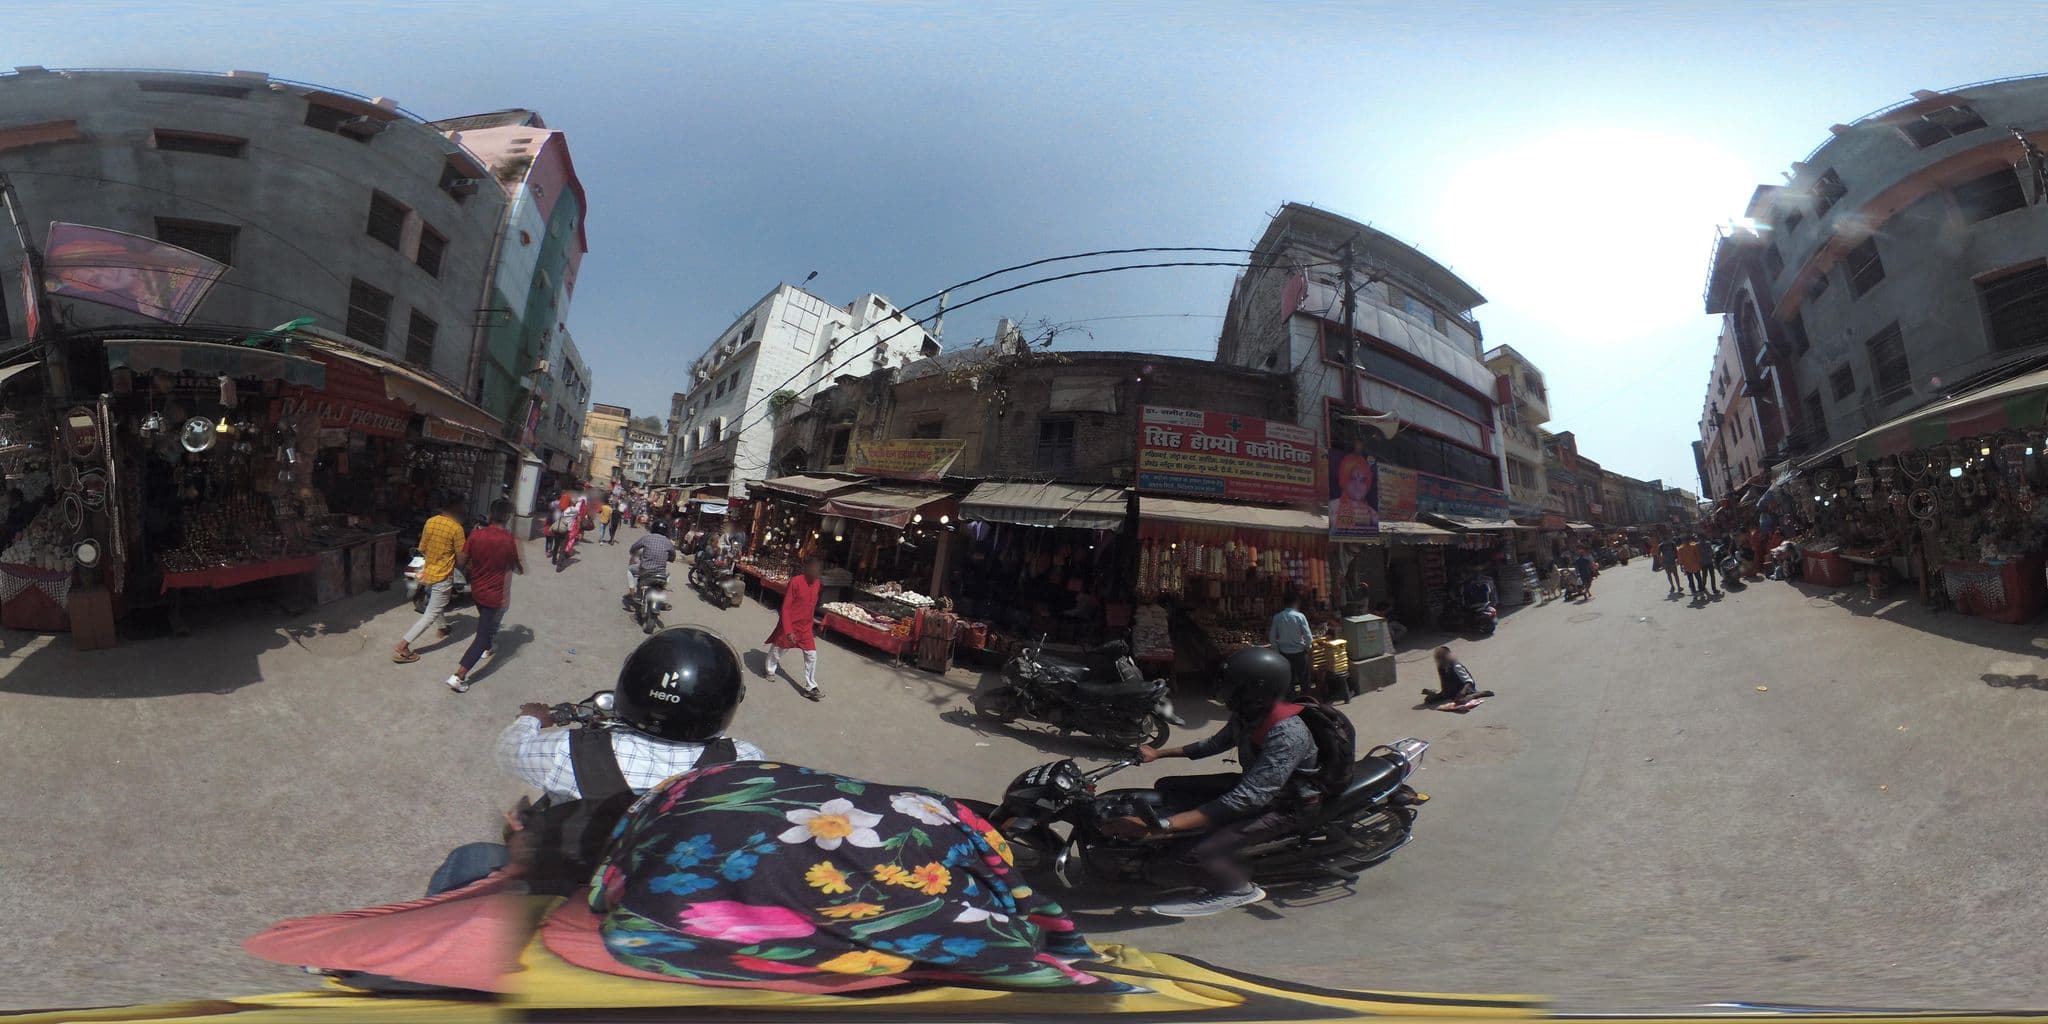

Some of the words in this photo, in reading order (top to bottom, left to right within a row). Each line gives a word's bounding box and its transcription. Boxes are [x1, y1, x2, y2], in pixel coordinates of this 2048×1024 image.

[350, 409, 409, 433] PICTURES
[1144, 426, 1183, 448] सिंह
[1189, 430, 1239, 454] होम्यो
[1245, 440, 1312, 464] क्लीनिक
[649, 689, 680, 703] Hero
